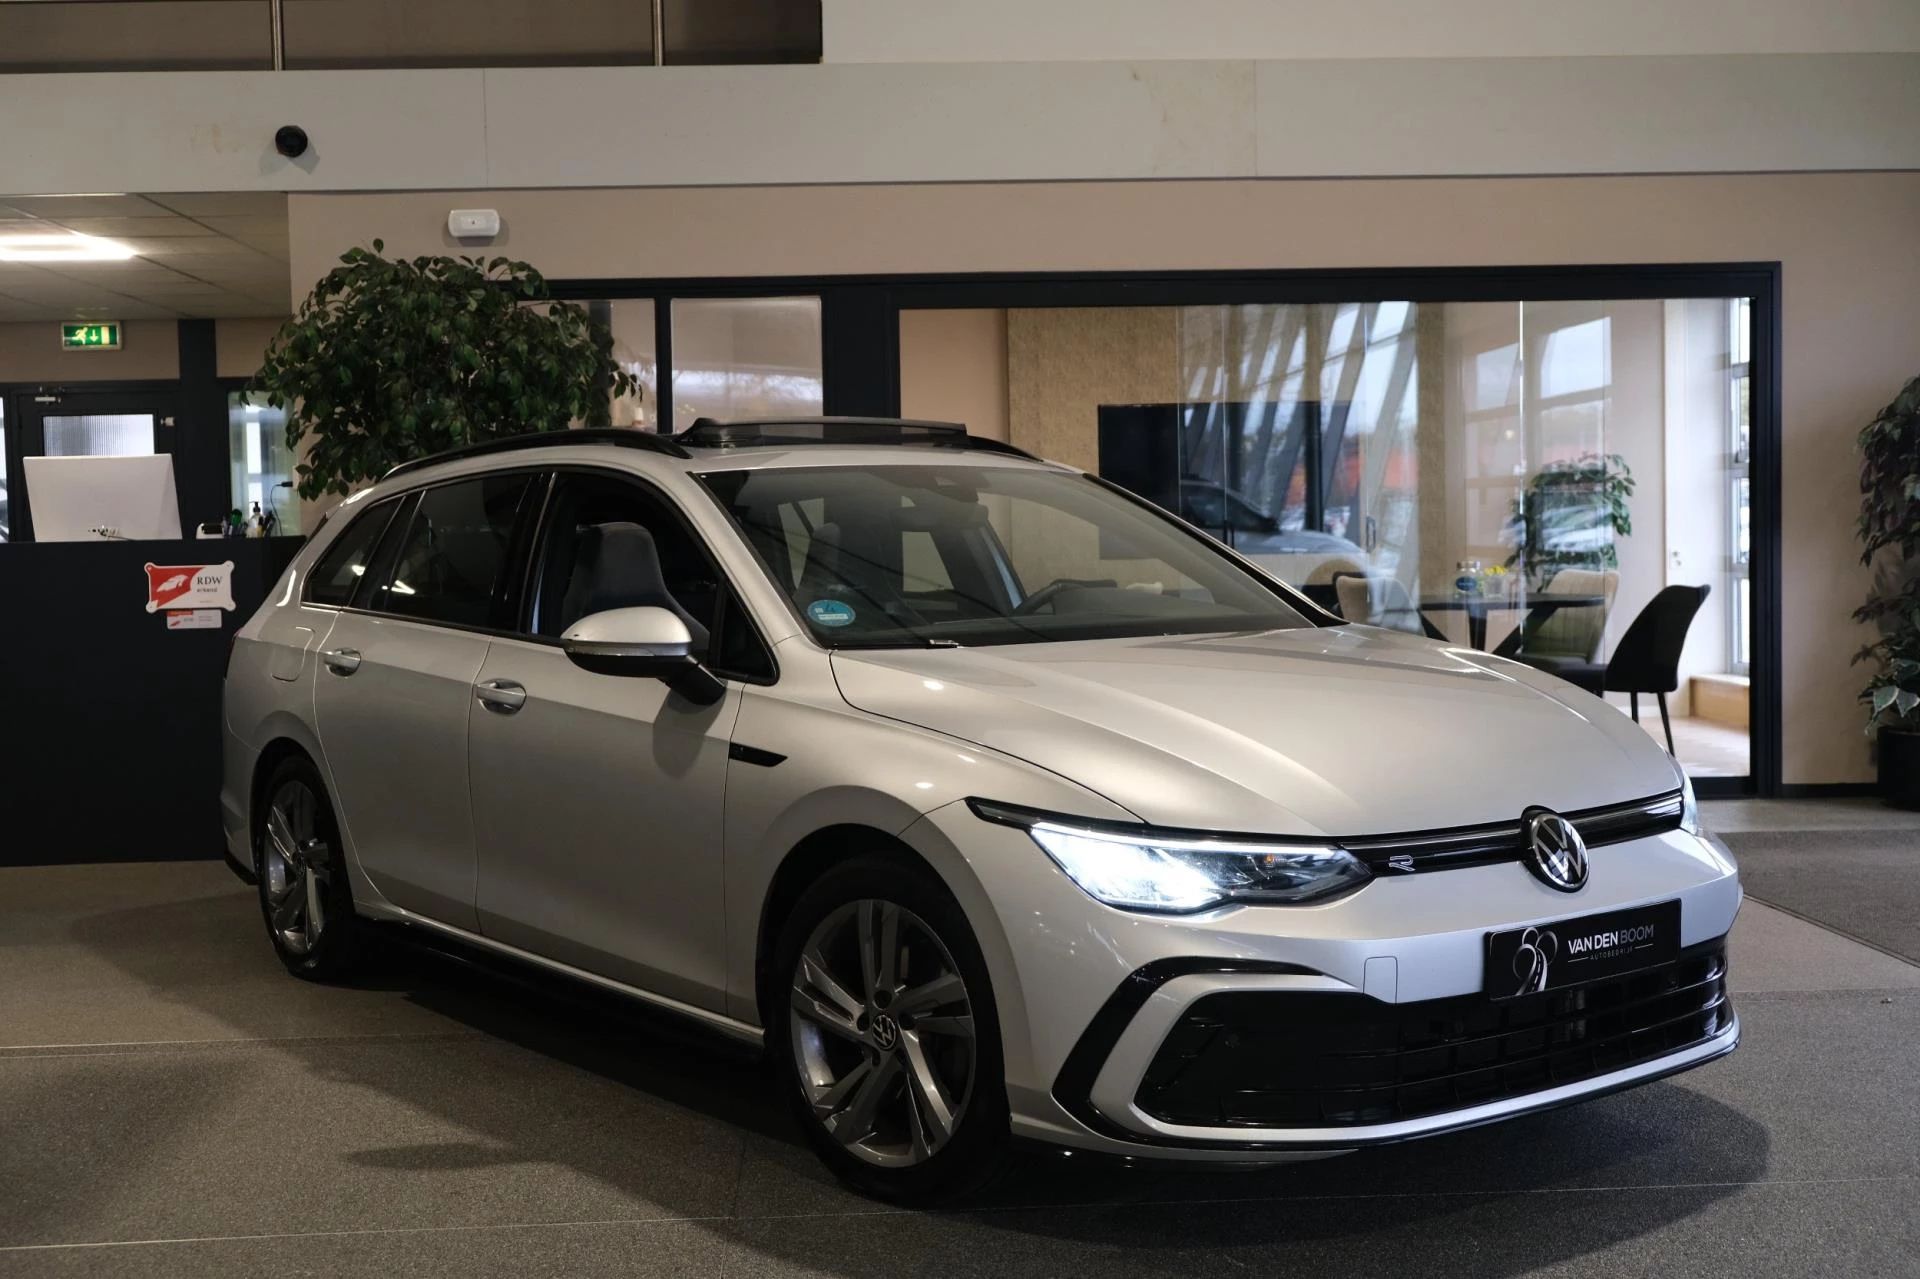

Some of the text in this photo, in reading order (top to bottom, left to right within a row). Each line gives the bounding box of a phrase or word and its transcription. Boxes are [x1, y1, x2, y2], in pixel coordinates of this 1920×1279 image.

[197, 576, 223, 585] RDW
[1389, 854, 1415, 872] R
[1568, 924, 1654, 954] VAN DEN BOOM
